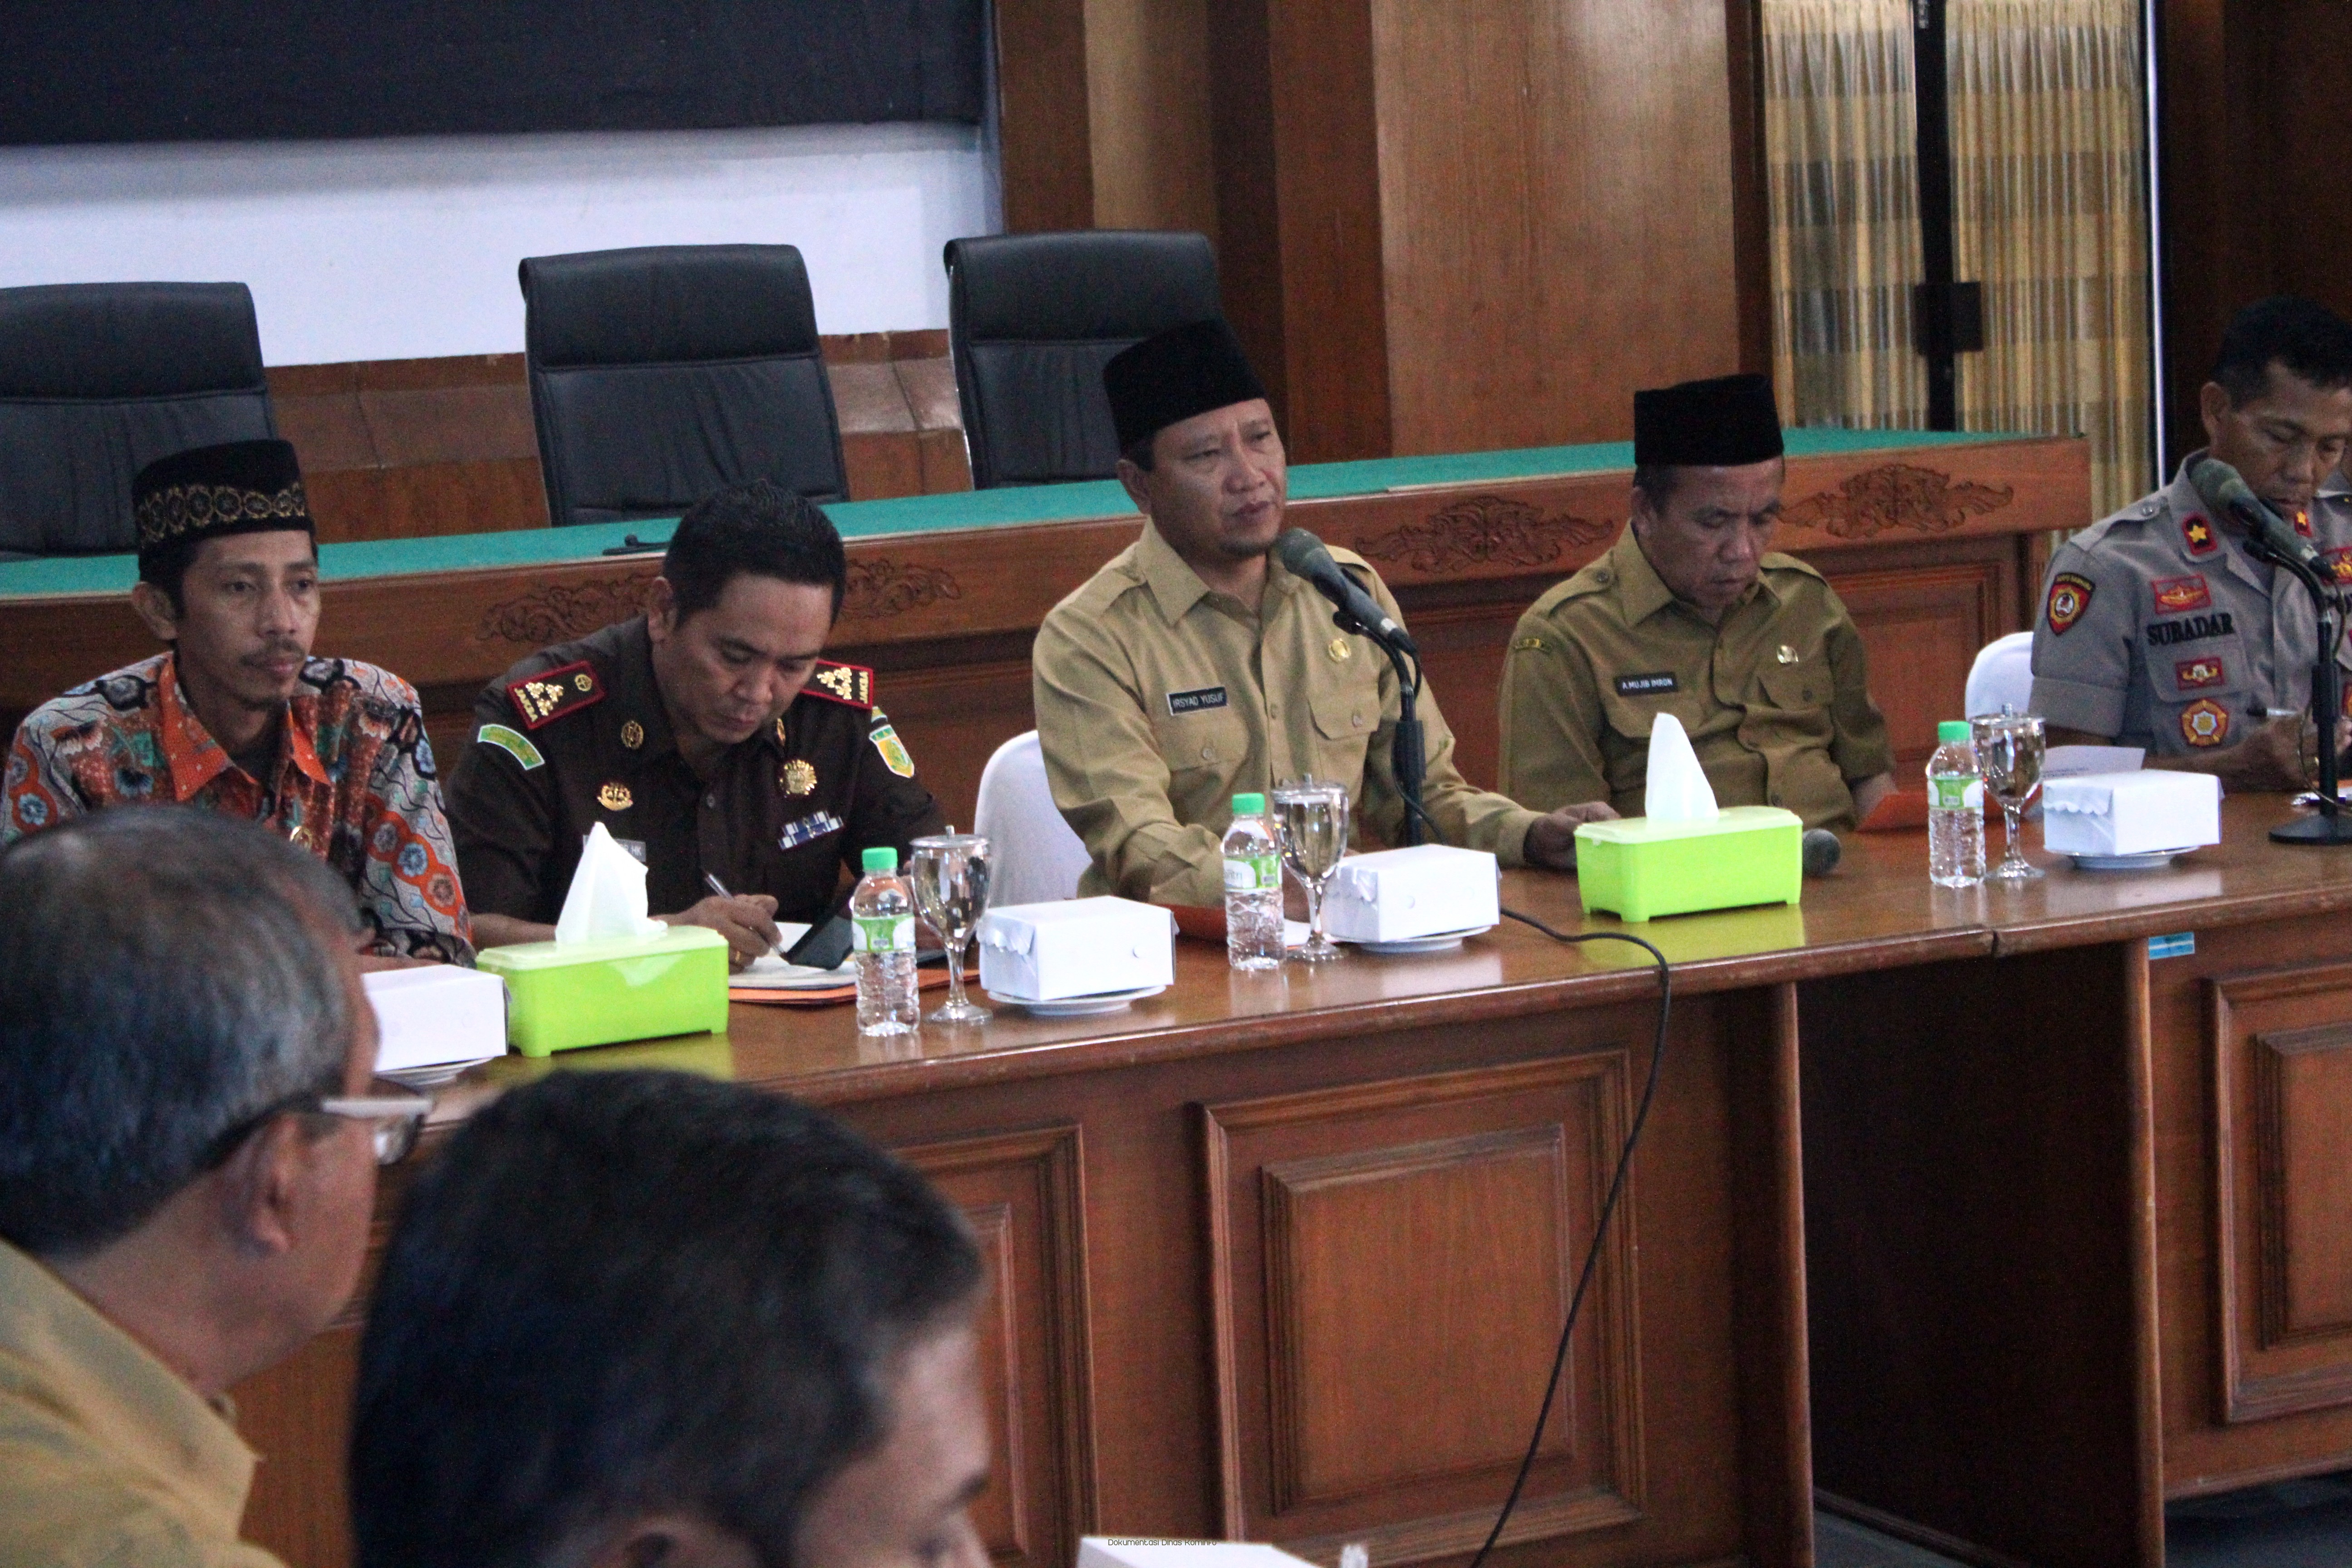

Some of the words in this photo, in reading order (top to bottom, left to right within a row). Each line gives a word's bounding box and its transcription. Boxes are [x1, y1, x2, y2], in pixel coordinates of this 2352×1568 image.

[1622, 681, 1628, 690] A
[1628, 679, 1651, 689] MUJIB
[1172, 696, 1199, 708] IRSYAD
[1200, 692, 1224, 705] YUSUF
